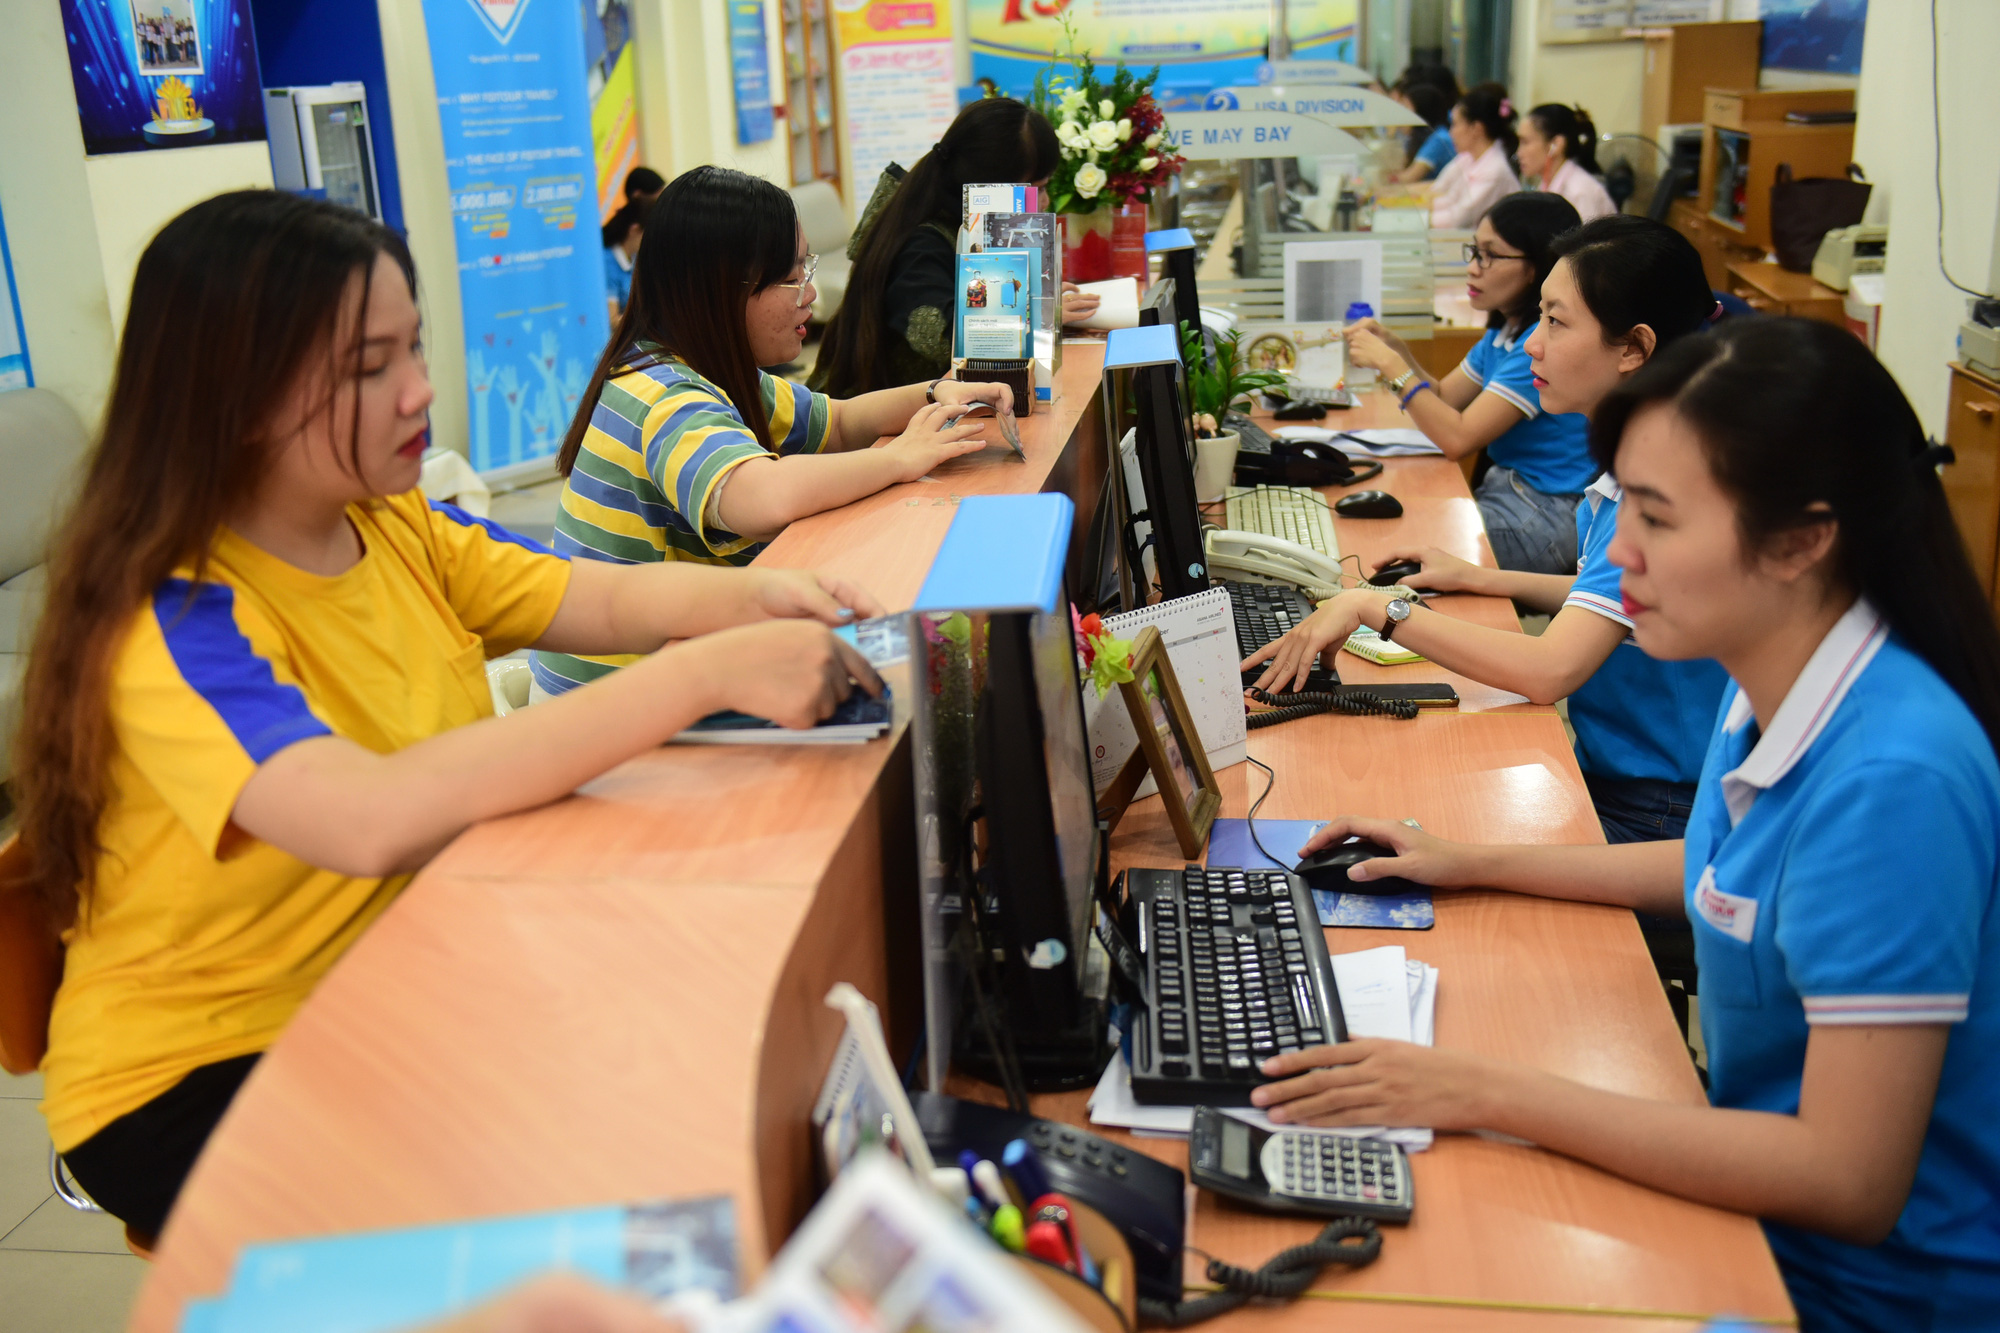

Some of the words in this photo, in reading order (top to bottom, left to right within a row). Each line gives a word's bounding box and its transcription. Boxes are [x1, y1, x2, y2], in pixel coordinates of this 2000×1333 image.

[1295, 98, 1364, 114] DIVISION
[1203, 127, 1244, 145] MAY
[1254, 125, 1292, 143] BAY
